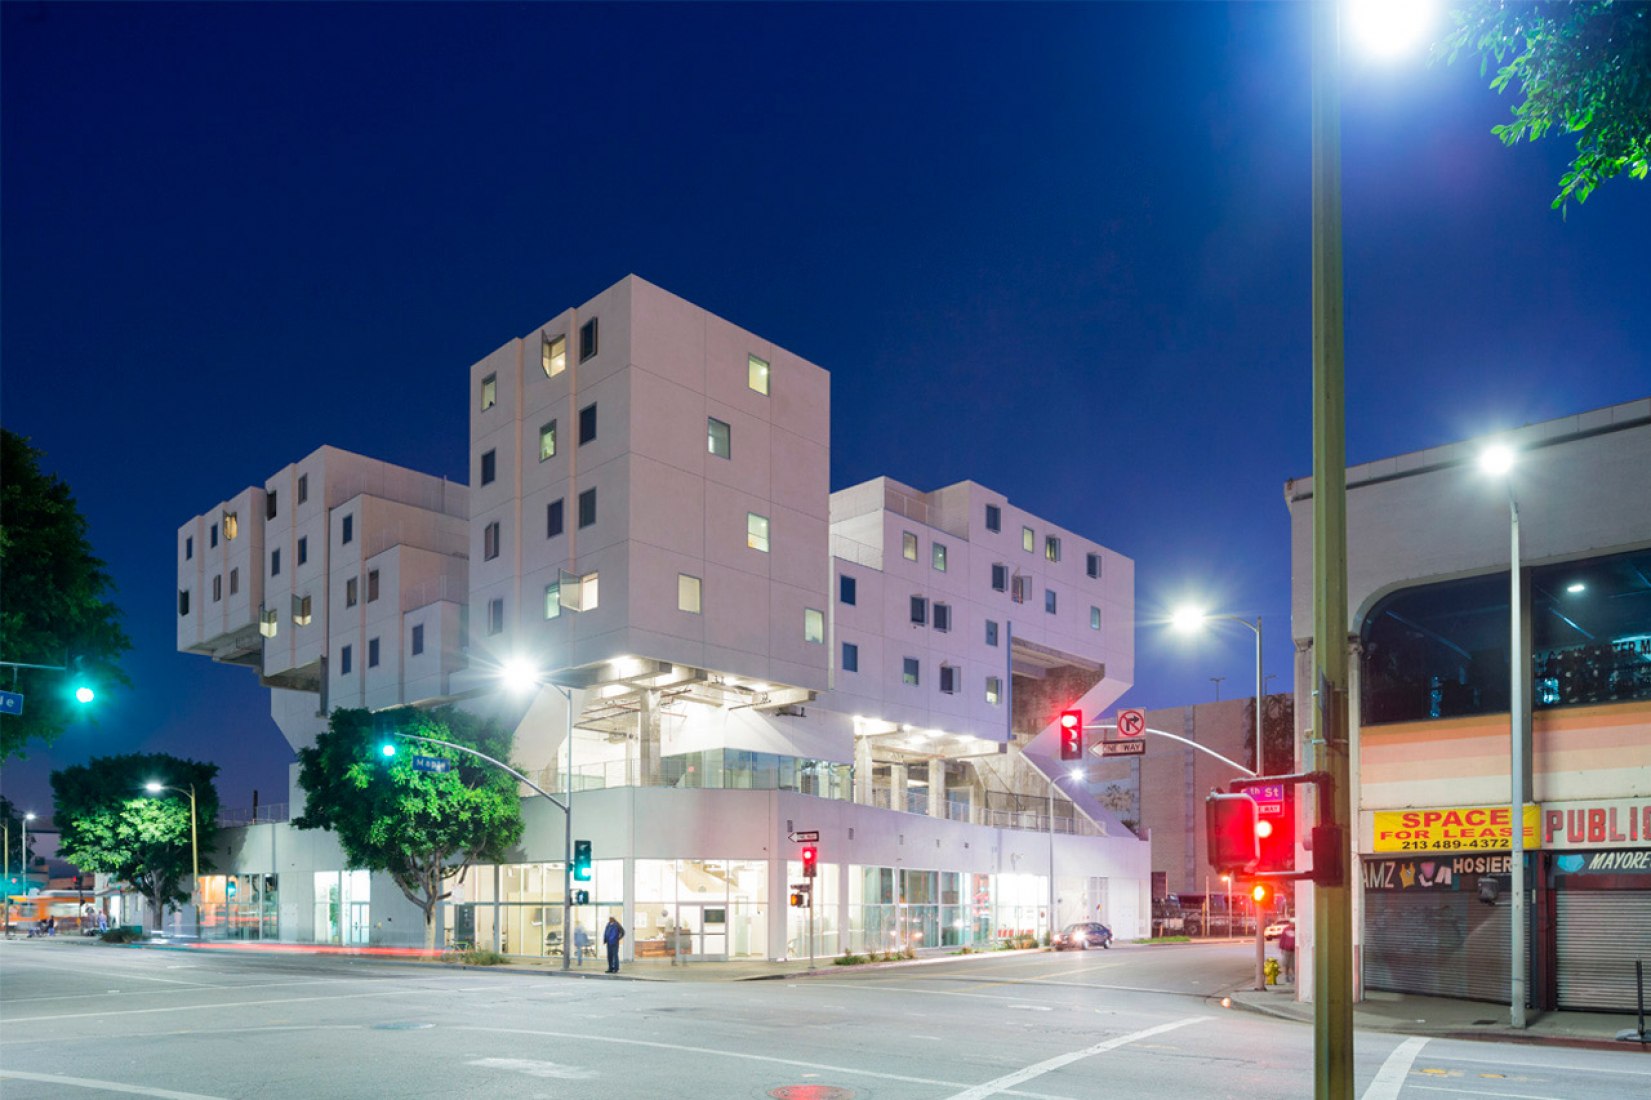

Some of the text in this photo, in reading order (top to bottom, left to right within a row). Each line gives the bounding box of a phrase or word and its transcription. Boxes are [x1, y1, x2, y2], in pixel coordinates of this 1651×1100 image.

[1265, 787, 1279, 798] St
[1402, 809, 1509, 828] SPACE
[1380, 827, 1534, 840] FOR LEASE
[1402, 838, 1509, 849] 213 489-4372
[1453, 856, 1513, 873] HOSIER
[1588, 851, 1651, 870] MAYORE
